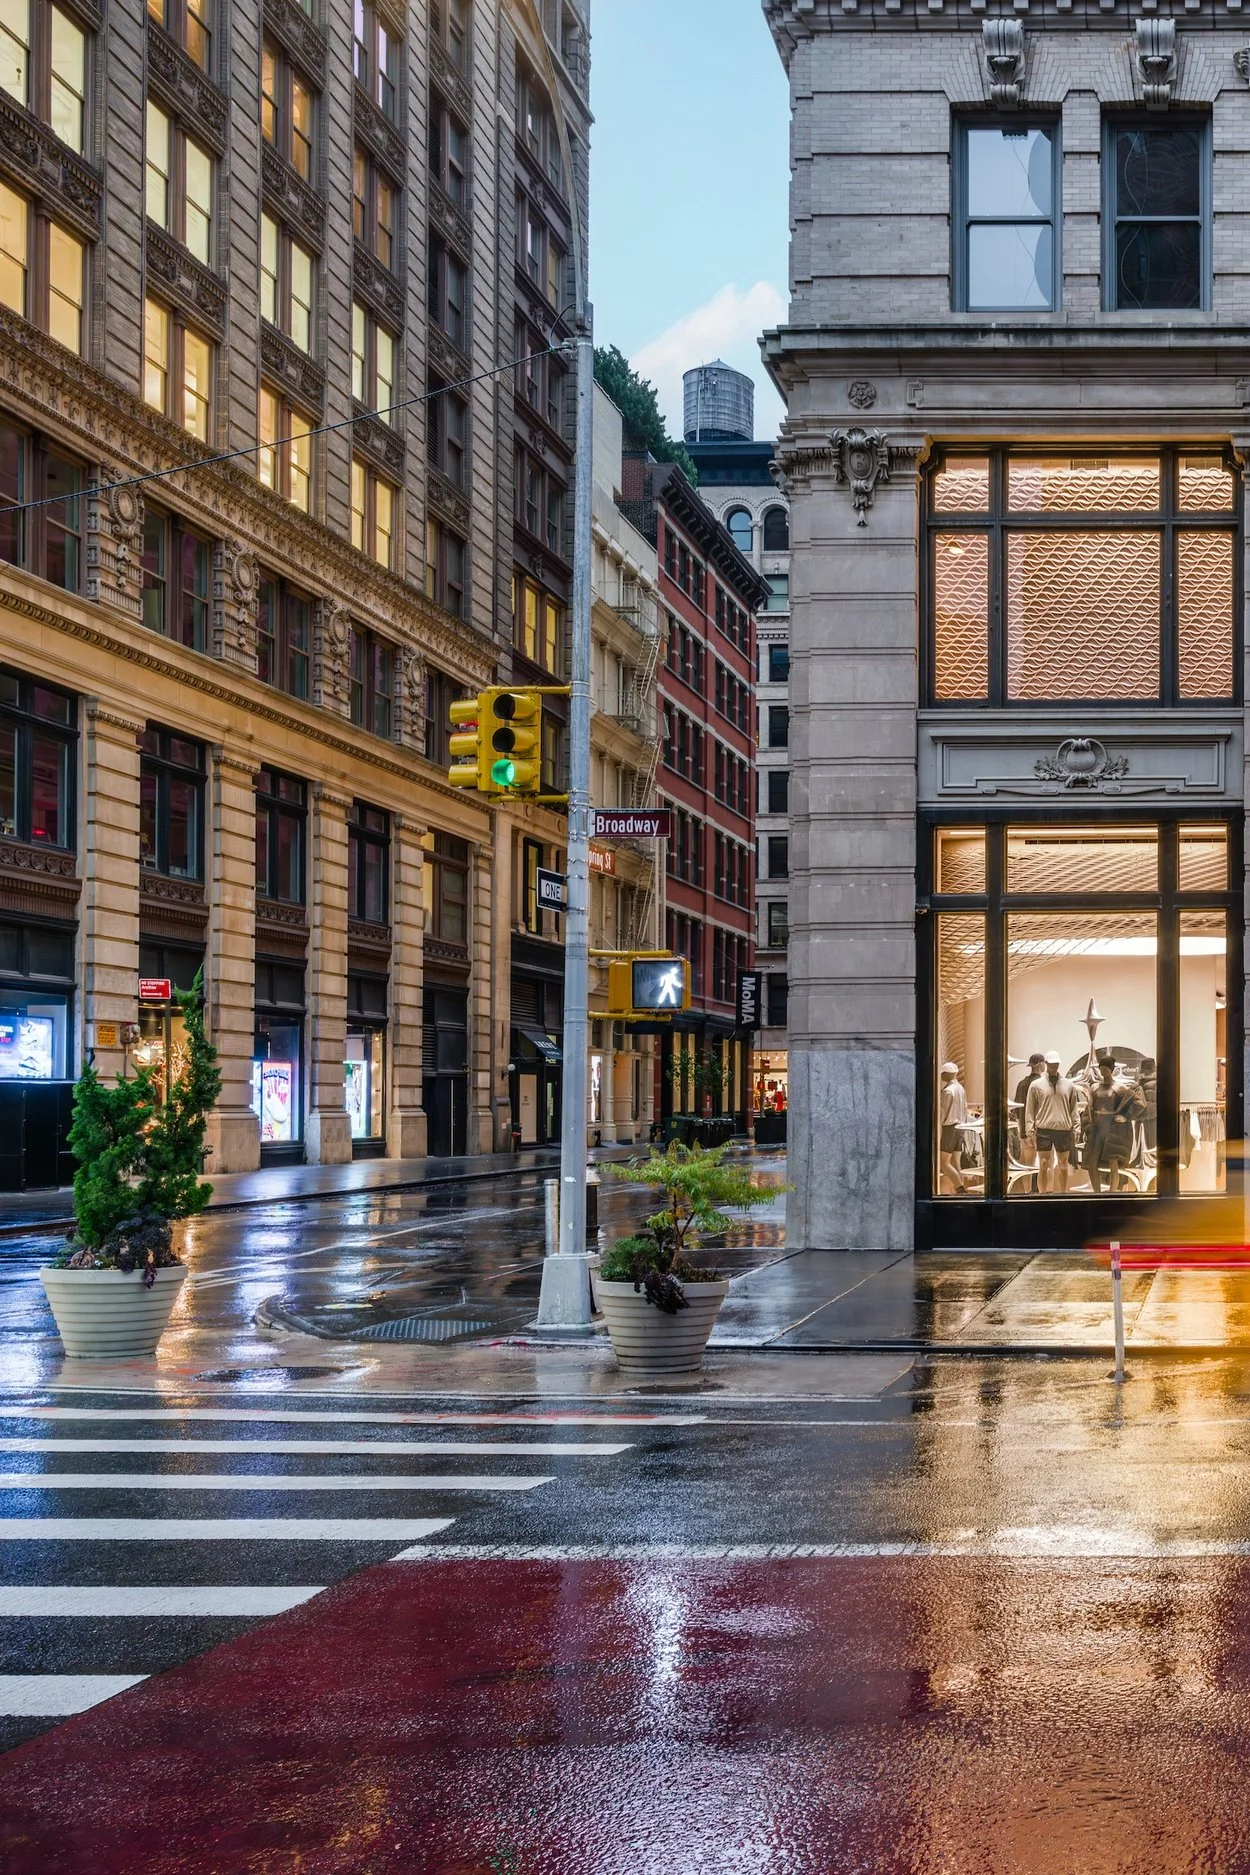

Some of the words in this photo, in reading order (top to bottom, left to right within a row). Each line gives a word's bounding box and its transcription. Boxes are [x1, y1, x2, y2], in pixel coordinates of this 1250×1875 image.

[596, 815, 660, 837] Broadway
[605, 851, 612, 870] St
[545, 882, 561, 900] ONE
[741, 976, 757, 1025] MoMA
